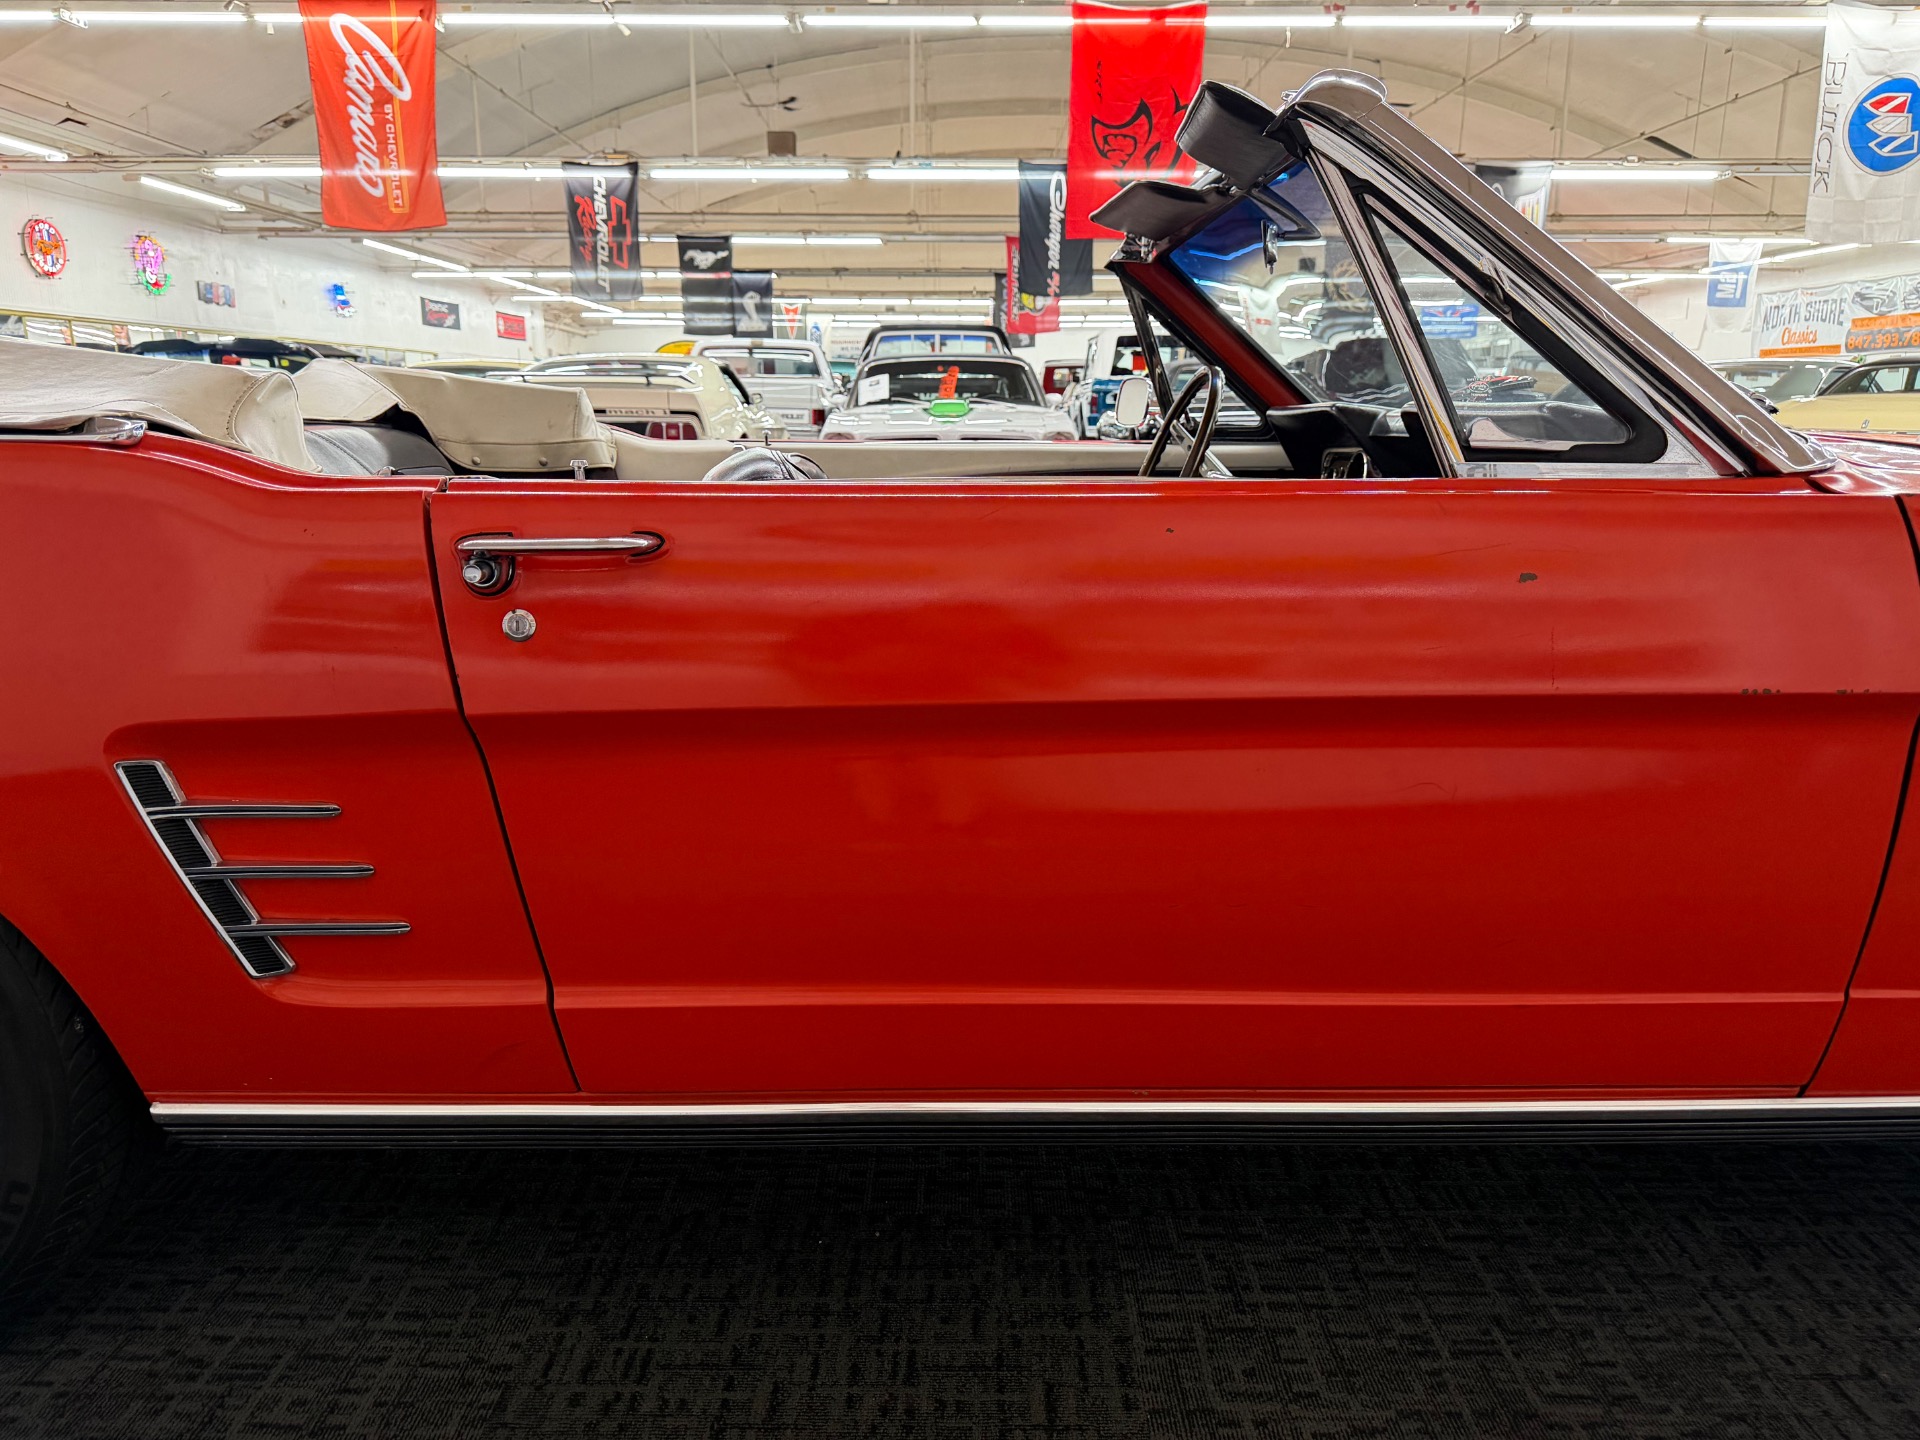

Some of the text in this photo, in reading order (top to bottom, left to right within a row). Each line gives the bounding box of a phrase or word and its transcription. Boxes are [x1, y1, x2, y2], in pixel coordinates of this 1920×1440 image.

[329, 13, 412, 198] Camaro
[383, 104, 403, 206] BY CHEVROLET
[1813, 52, 1849, 193] BUICK
[593, 176, 611, 293] CHEVROLET
[1044, 171, 1067, 270] Charger
[1715, 271, 1738, 299] GM
[1762, 304, 1801, 332] NORTH
[1804, 297, 1847, 326] SHORE
[1781, 325, 1818, 346] Classics
[1847, 331, 1920, 350] 847.393.78
